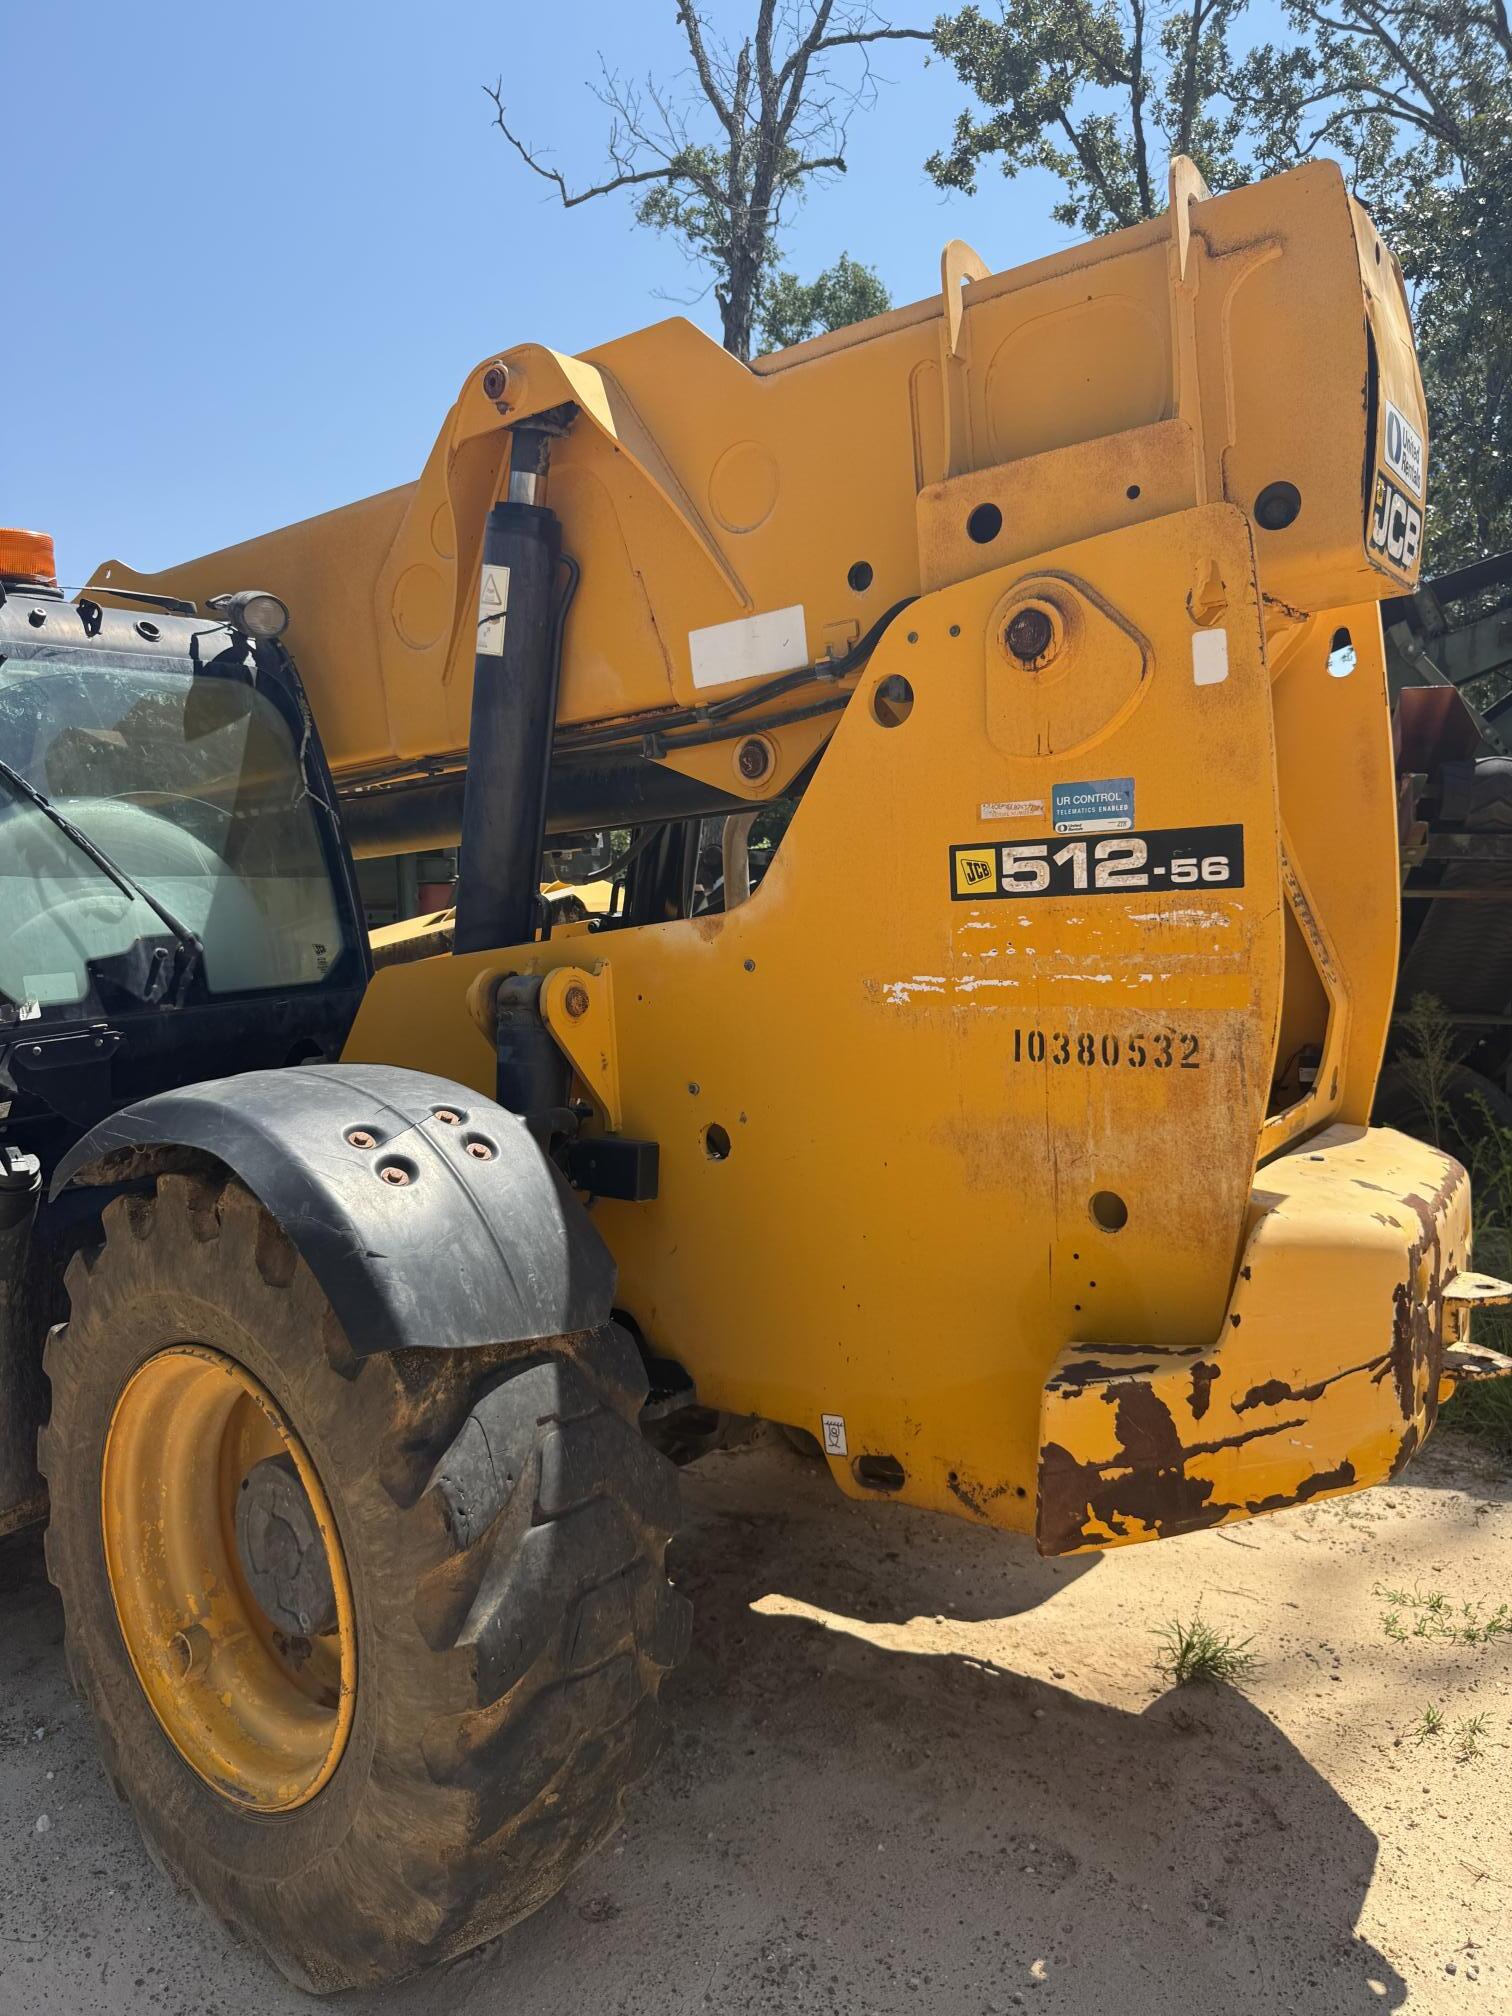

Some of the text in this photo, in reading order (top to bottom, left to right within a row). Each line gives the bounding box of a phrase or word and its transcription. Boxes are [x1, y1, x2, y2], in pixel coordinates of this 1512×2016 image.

[1402, 426, 1420, 465] United
[1401, 450, 1420, 489] Rentals
[1371, 485, 1422, 570] JCB
[1056, 792, 1122, 806] UR CONTROL
[1056, 804, 1129, 816] TELEMATICS ENABLED
[966, 861, 990, 884] JCB
[1001, 838, 1231, 892] 512-56
[1013, 1028, 1201, 1069] 10380532
